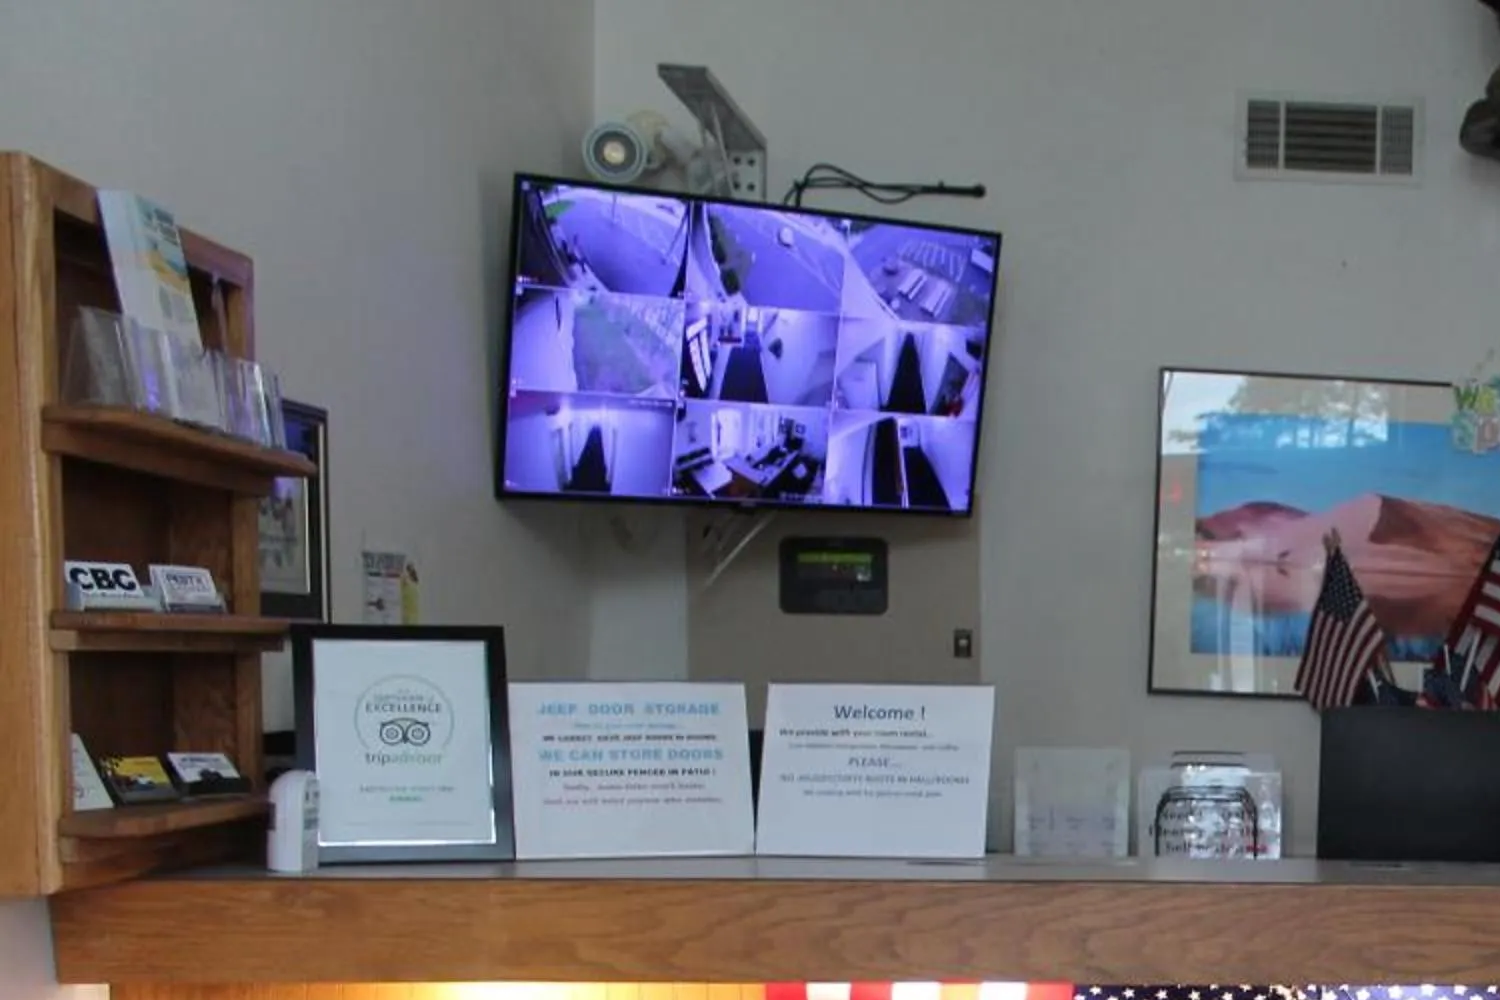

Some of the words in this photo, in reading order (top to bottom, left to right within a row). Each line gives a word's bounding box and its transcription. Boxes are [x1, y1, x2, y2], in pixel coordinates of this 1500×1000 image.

[365, 703, 442, 713] EXCELLENCE
[537, 703, 578, 716] JEEP
[588, 703, 634, 716] DOOR
[643, 702, 721, 715] STORAGE
[833, 704, 914, 720] Welcome
[921, 705, 926, 720] !
[538, 749, 564, 761] WE
[568, 749, 603, 761] CAN
[608, 748, 660, 760] STORE
[668, 748, 724, 760] DOORS
